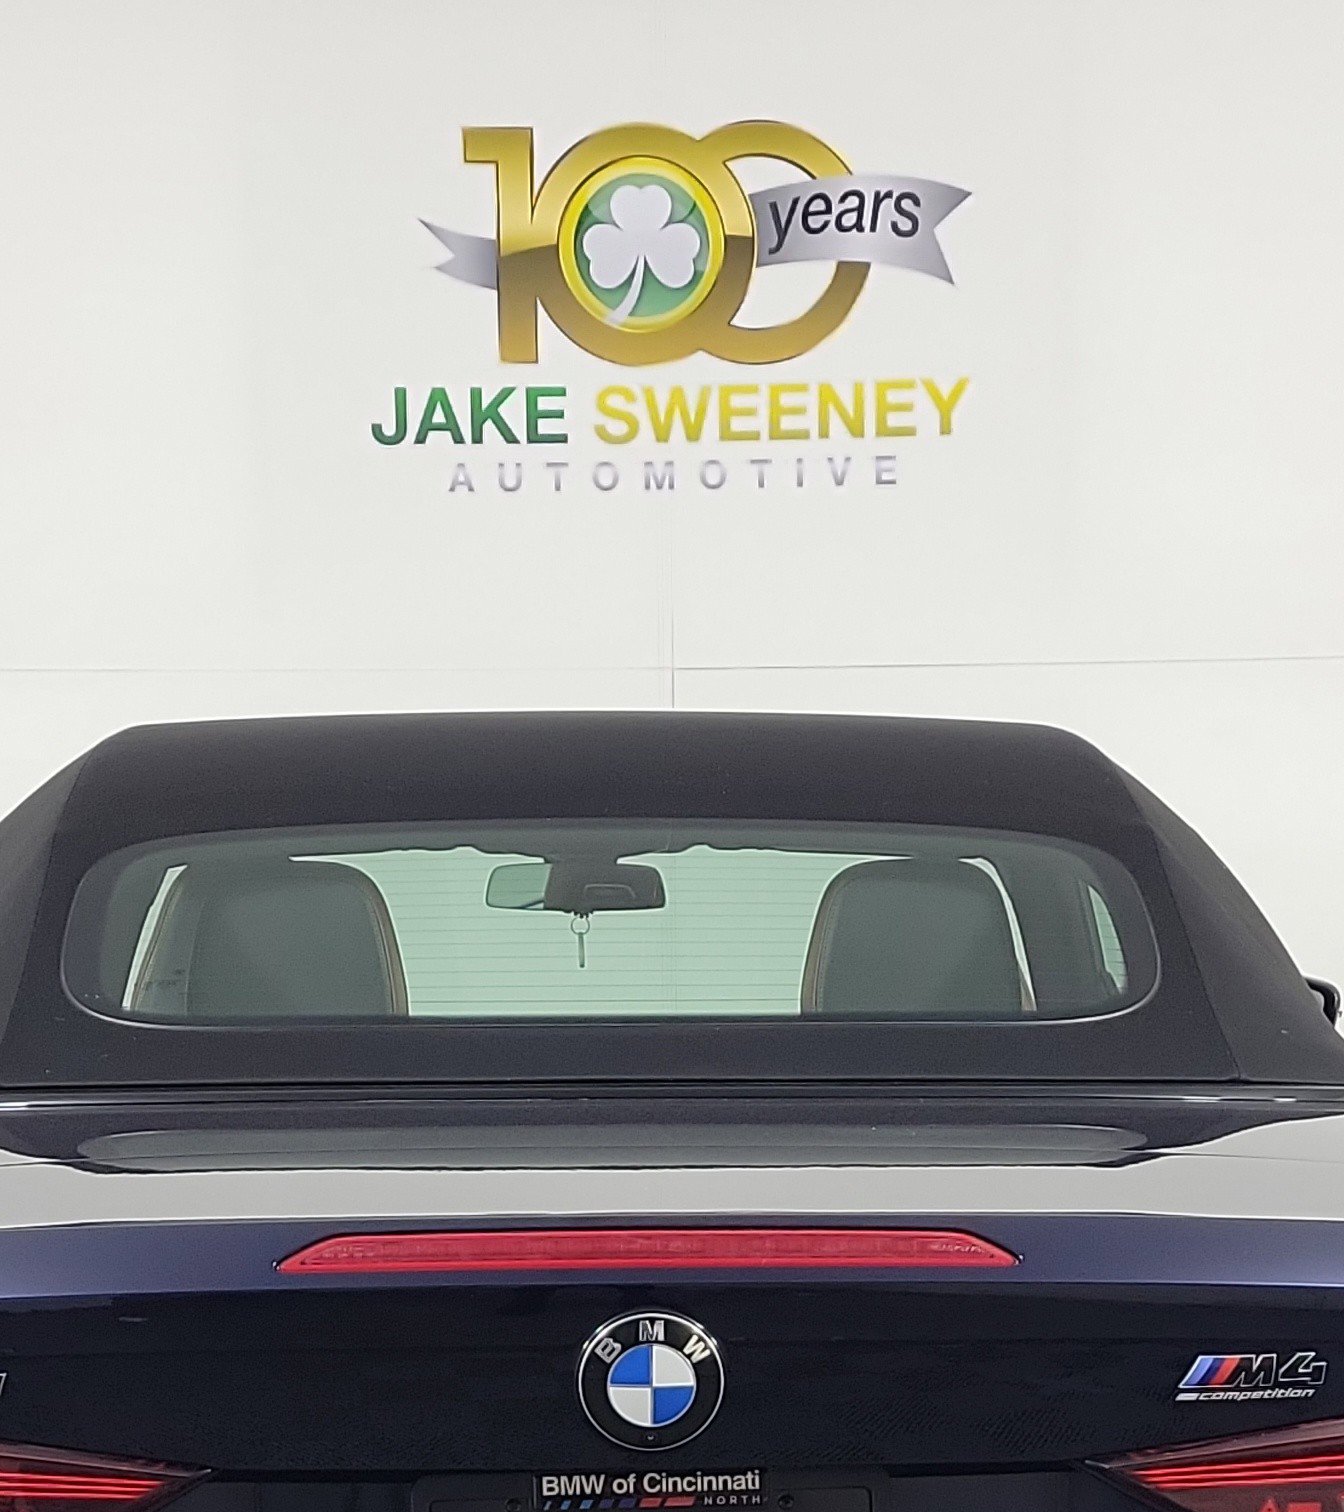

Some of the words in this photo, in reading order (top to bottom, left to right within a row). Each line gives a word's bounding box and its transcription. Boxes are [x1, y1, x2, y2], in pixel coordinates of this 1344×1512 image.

[461, 120, 872, 366] 100
[768, 187, 922, 254] years
[372, 386, 567, 446] JAKE
[593, 377, 970, 444] SWEENEY
[448, 456, 898, 493] AUTOMOTIVE
[594, 1320, 710, 1364] BMW
[1191, 1352, 1328, 1388] M4
[1198, 1387, 1316, 1401] competition
[542, 1474, 605, 1496] BMW
[612, 1474, 636, 1494] of
[643, 1470, 760, 1493] Cincinnati
[704, 1495, 761, 1505] NORTH
